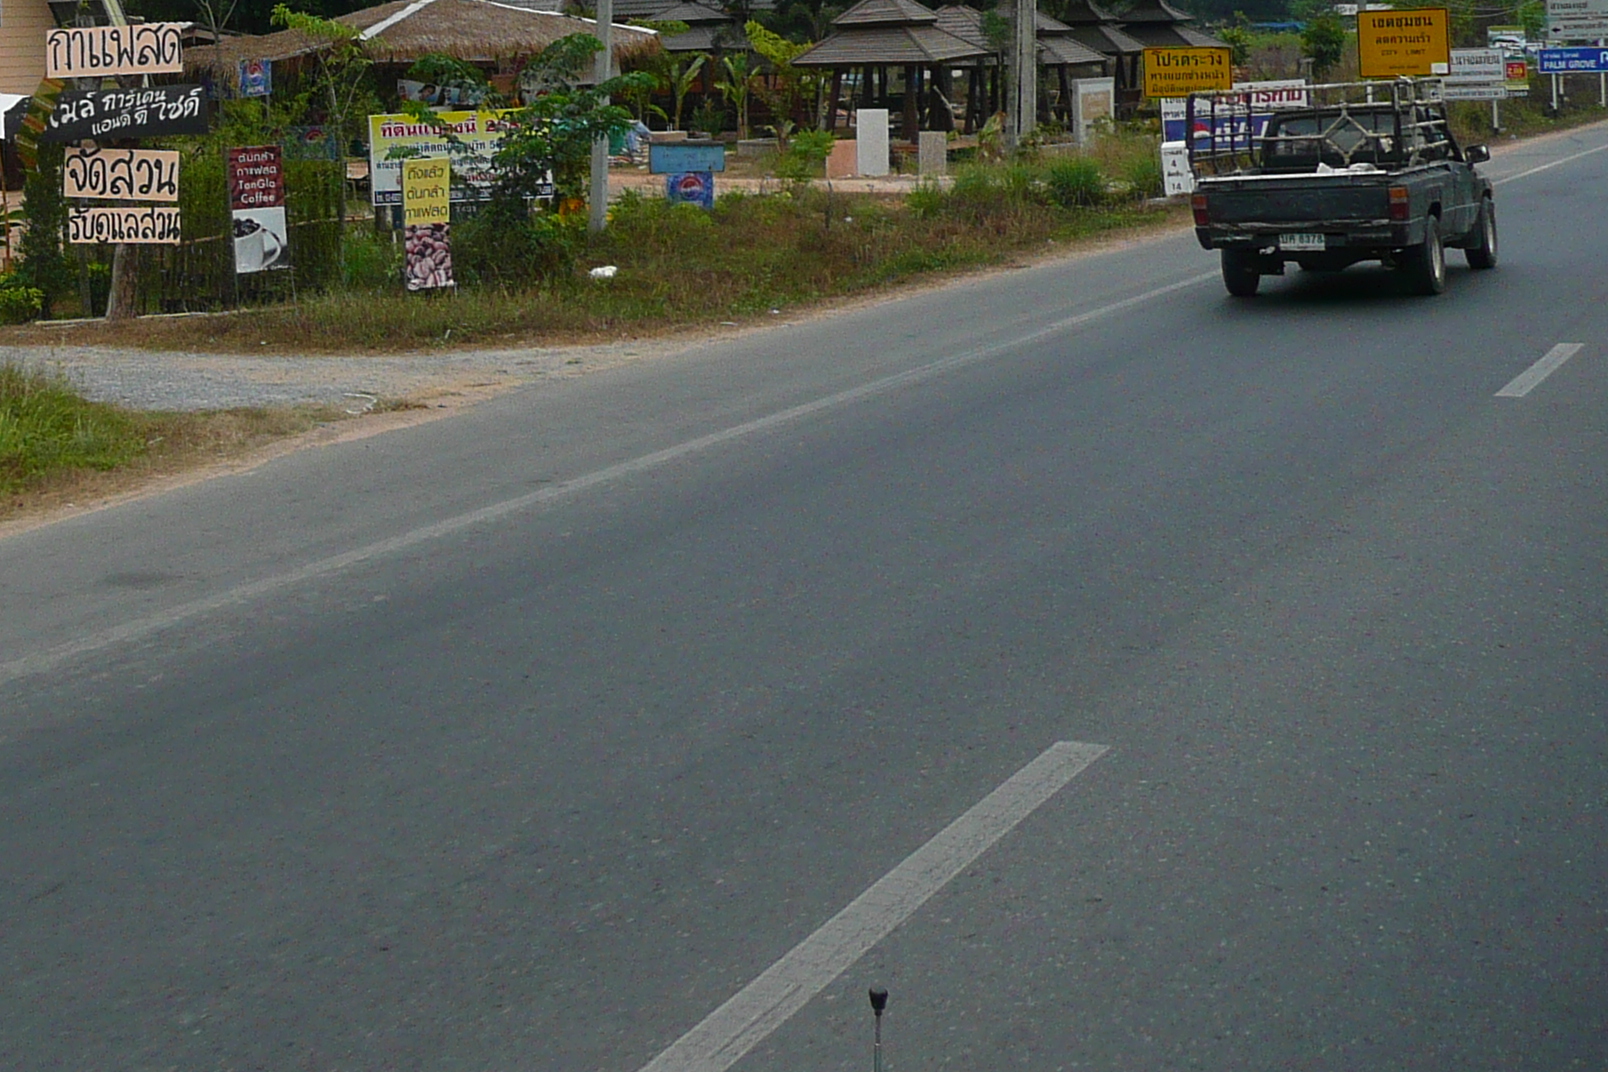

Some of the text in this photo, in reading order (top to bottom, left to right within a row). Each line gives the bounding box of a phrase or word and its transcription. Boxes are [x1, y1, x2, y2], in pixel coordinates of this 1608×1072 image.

[48, 24, 181, 70] กาแฟสด
[1151, 51, 1223, 67] โปรดระวัง
[66, 147, 176, 197] จัดสวน
[240, 192, 276, 204] Coffee
[69, 208, 180, 243] รับดูแลสวน
